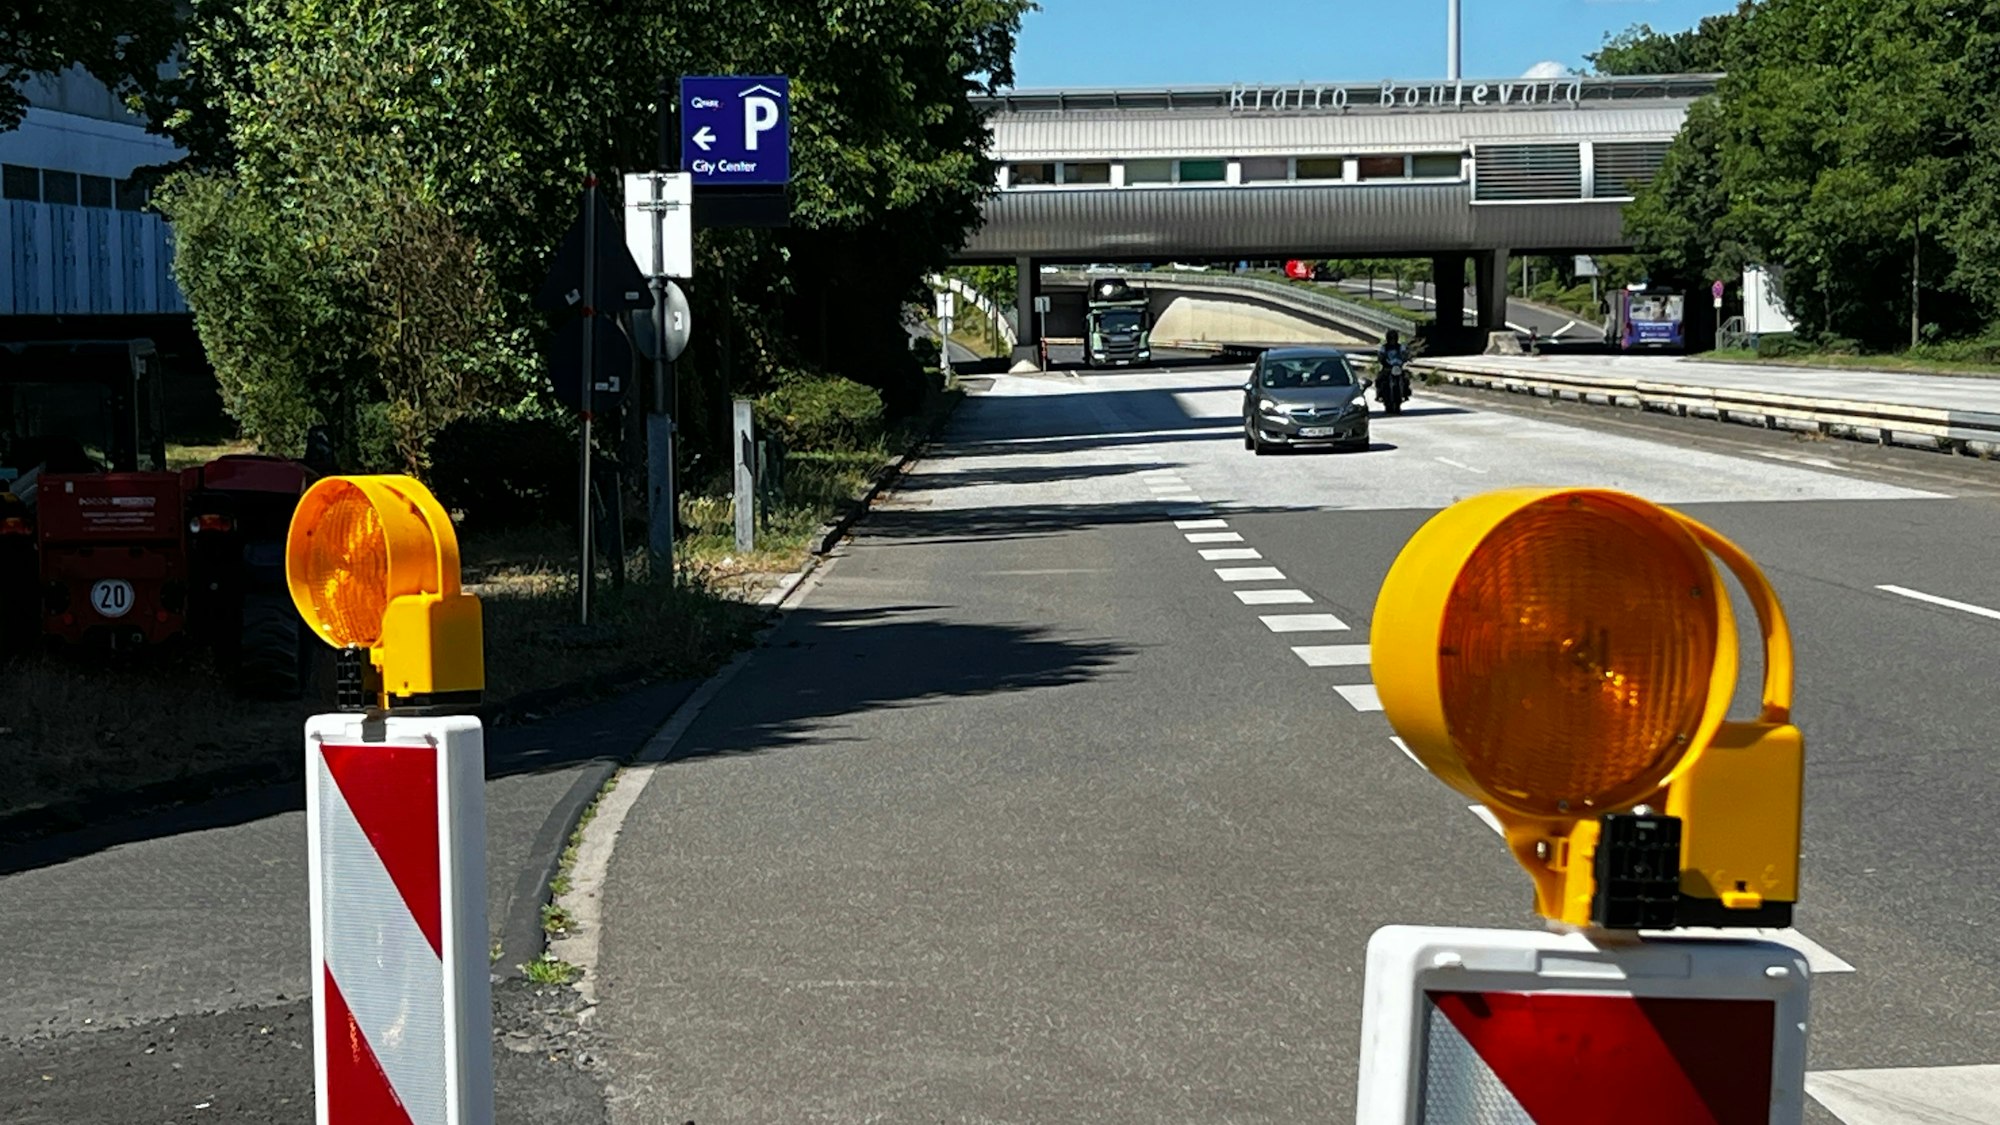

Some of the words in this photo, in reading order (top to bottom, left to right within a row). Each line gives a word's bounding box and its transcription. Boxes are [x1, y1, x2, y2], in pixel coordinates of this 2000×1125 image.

[1229, 80, 1348, 112] Rialto
[1378, 76, 1584, 110] Boulevard
[744, 96, 779, 151] P
[692, 159, 716, 176] City
[718, 159, 757, 172] Center
[100, 584, 125, 609] 20
